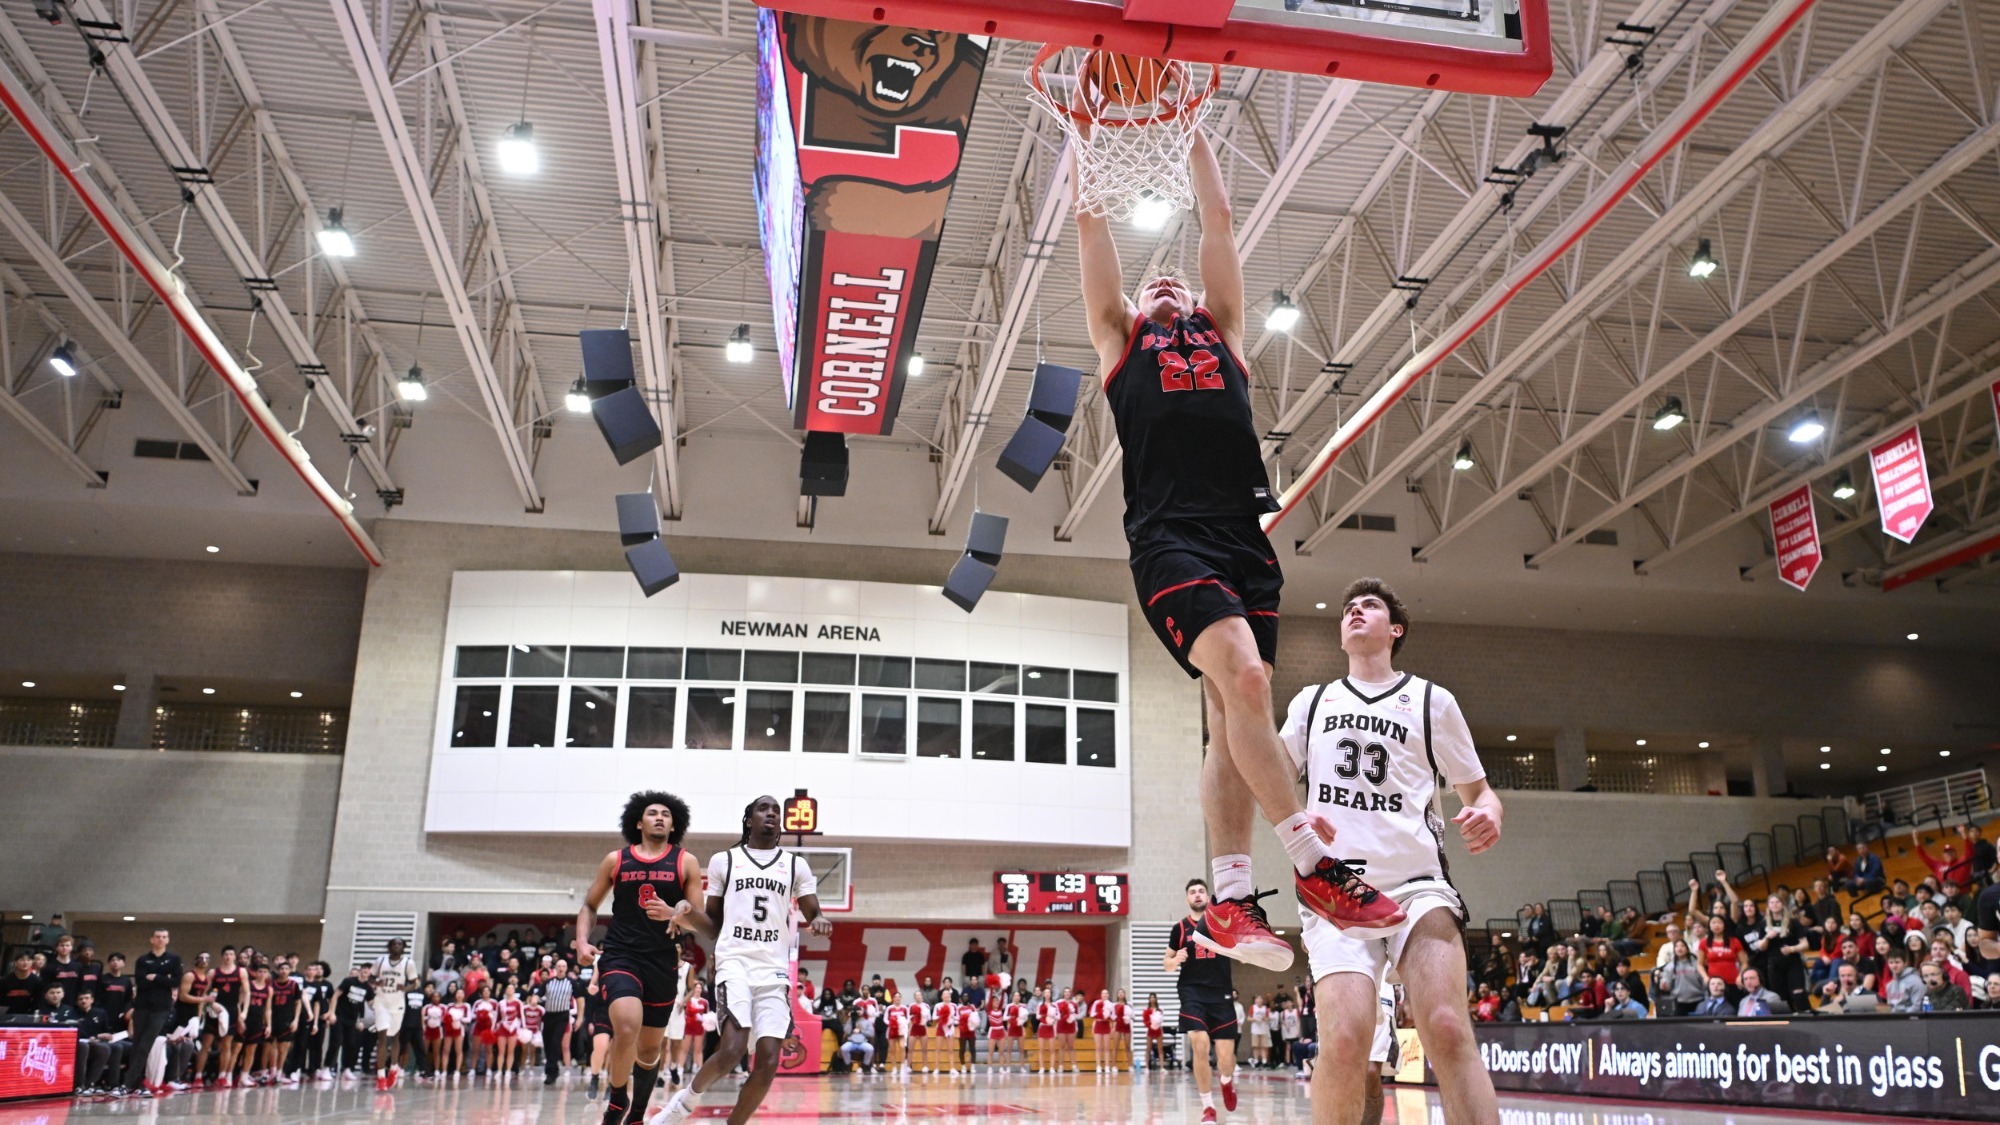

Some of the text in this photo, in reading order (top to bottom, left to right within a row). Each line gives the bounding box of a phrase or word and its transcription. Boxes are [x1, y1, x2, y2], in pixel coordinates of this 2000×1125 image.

[816, 267, 907, 417] CORNELL
[1158, 349, 1225, 392] 22
[721, 620, 881, 642] NEWMAN ARENA
[1322, 713, 1409, 745] BROWN
[1334, 737, 1390, 787] 33
[1318, 783, 1403, 812] BEARS
[786, 808, 814, 830] 29
[621, 870, 675, 882] BIG RED
[735, 877, 788, 897] BROWN
[638, 884, 655, 909] 8
[1007, 884, 1121, 905] 39 40
[1051, 902, 1073, 912] period
[753, 896, 769, 923] 5
[733, 925, 779, 943] BEARS
[1481, 1043, 1490, 1071] &
[1491, 1043, 1530, 1073] Doors
[1532, 1043, 1548, 1074] of
[1550, 1043, 1582, 1074] CNY
[1599, 1044, 1662, 1086] Always
[1665, 1043, 1733, 1088] aiming
[1737, 1043, 1770, 1082] for
[1775, 1044, 1831, 1085] best
[1836, 1044, 1862, 1086] in
[1869, 1045, 1944, 1097] glass
